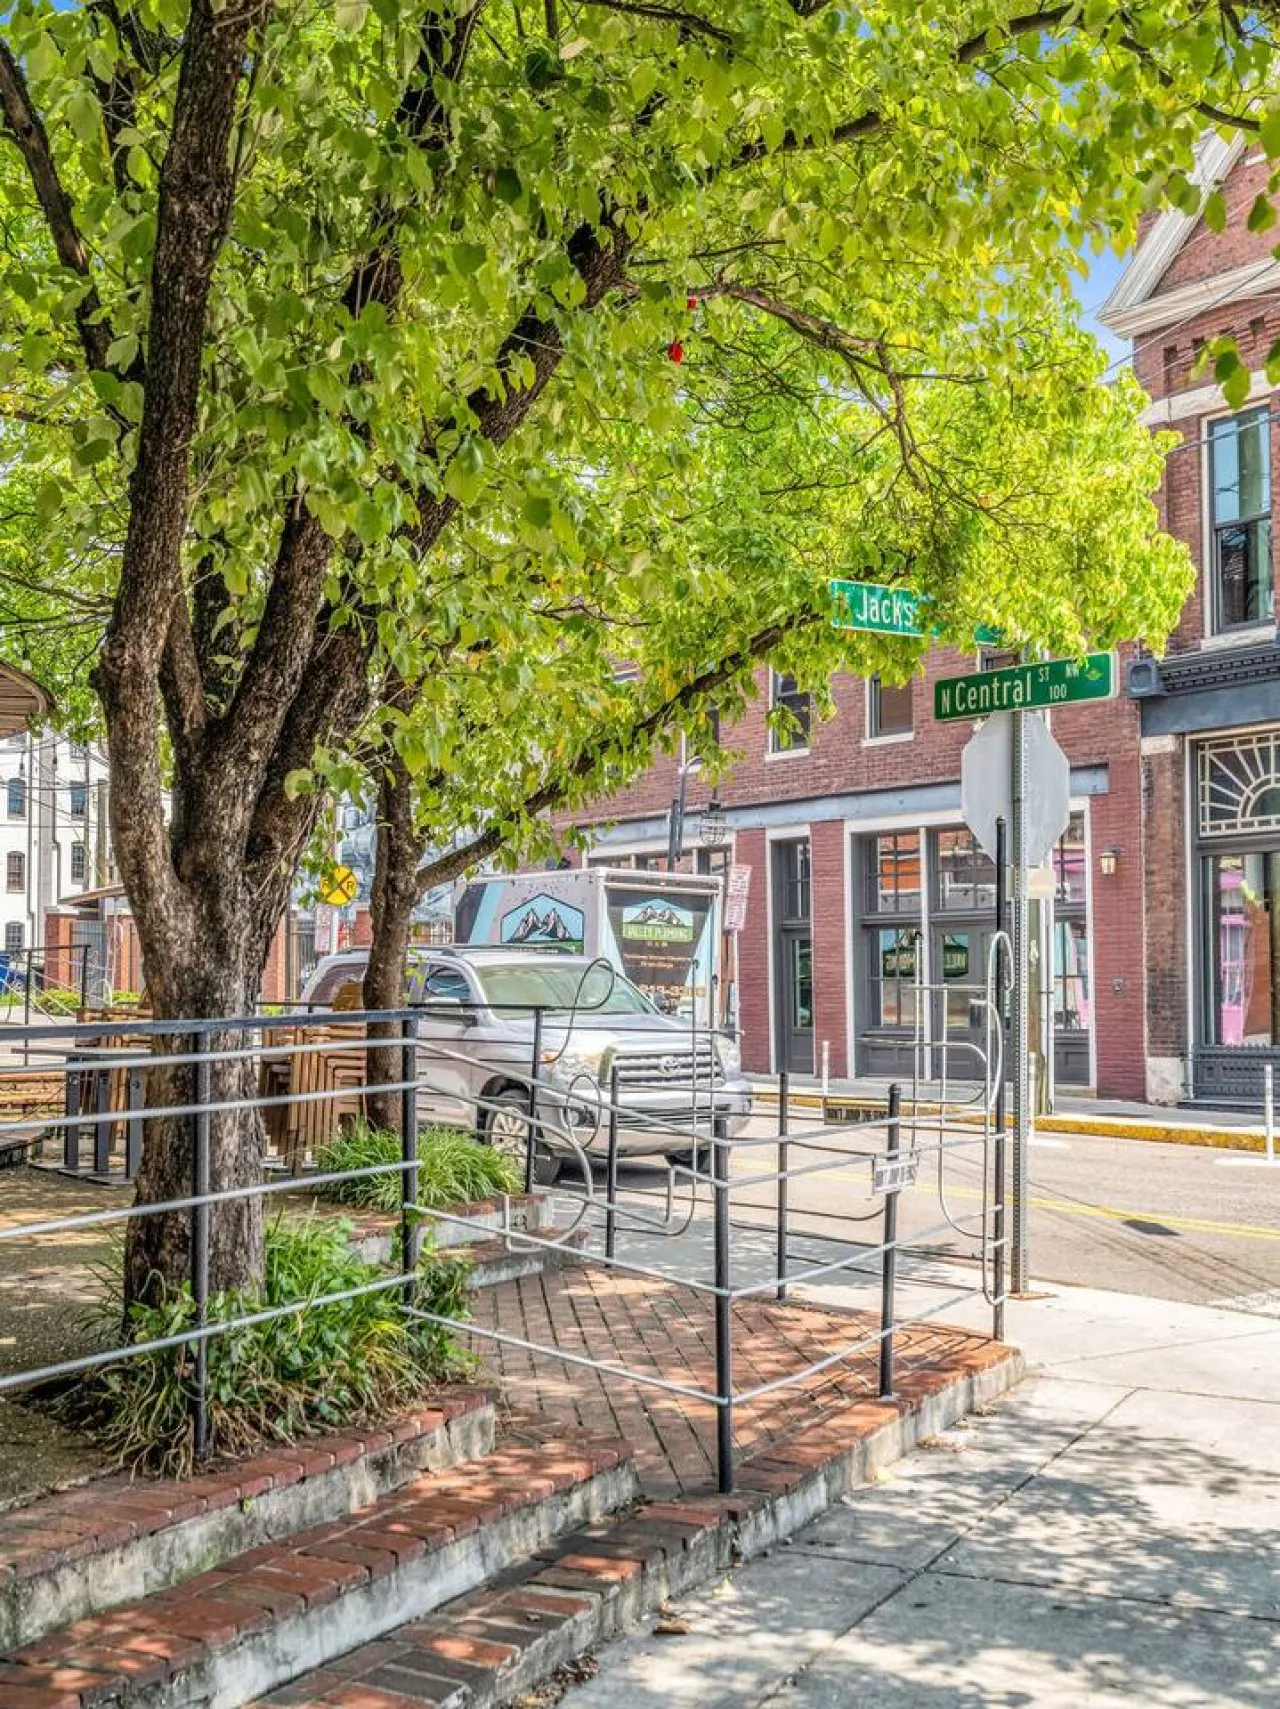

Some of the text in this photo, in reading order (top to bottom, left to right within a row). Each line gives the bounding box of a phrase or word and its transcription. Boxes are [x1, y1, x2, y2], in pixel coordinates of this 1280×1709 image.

[856, 588, 914, 626] Jacks
[941, 688, 950, 713] N
[955, 671, 1032, 712] Central
[1050, 683, 1068, 699] 100
